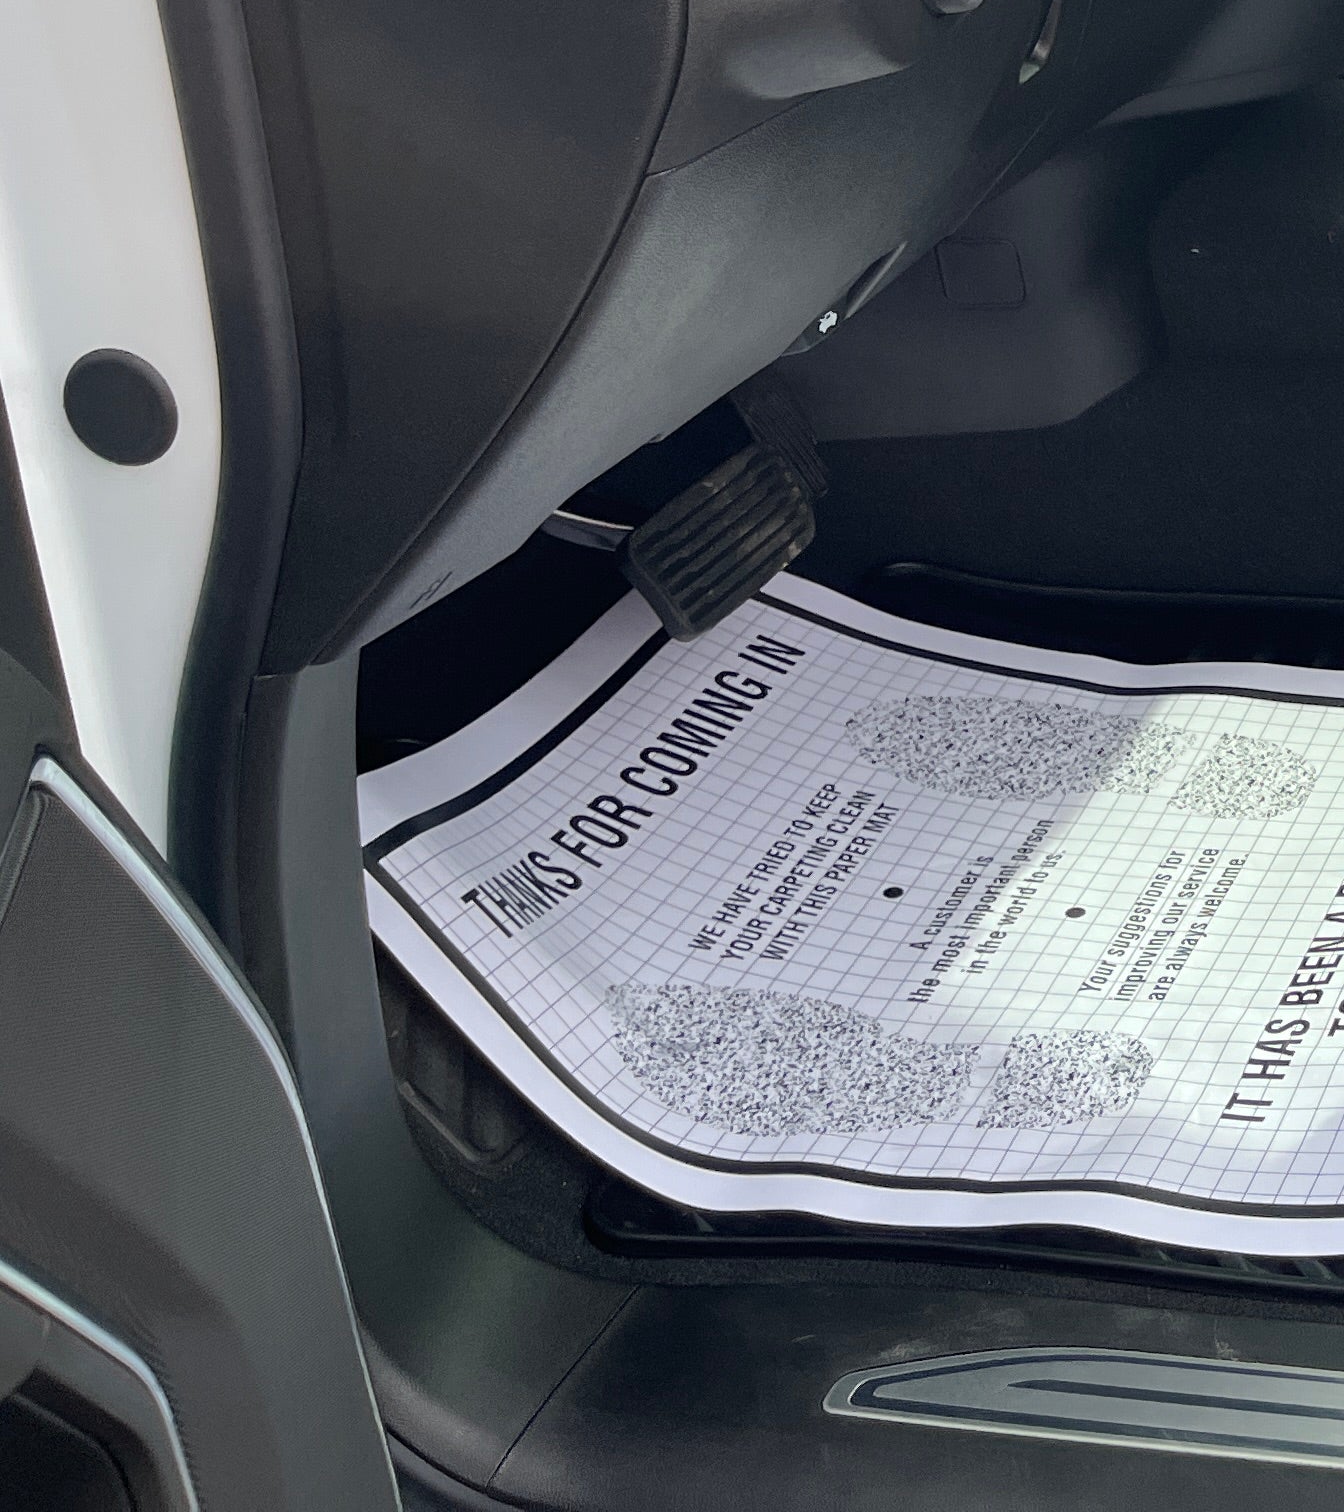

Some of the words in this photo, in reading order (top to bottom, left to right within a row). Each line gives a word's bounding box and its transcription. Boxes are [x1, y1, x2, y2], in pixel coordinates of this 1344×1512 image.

[460, 851, 583, 938] THANKS
[550, 794, 654, 868] FOR
[619, 670, 772, 796] COMING
[737, 634, 805, 675] IN
[688, 924, 726, 951] WE
[712, 884, 760, 924] HAVE
[746, 840, 795, 882] TRIED
[783, 819, 814, 838] TO
[802, 783, 842, 818] KEEP
[720, 918, 773, 961] YOUR
[760, 835, 838, 916] CARPETING
[827, 790, 876, 834] CLEAN
[759, 920, 809, 961] WITH
[794, 884, 838, 917] THIS
[824, 836, 877, 882] PAPER
[862, 802, 900, 834] MAT
[907, 978, 940, 1004] the
[932, 934, 970, 972] most
[955, 865, 1020, 930] important
[1011, 819, 1055, 862] person
[910, 940, 932, 950] A
[924, 871, 981, 936] customer
[968, 855, 994, 867] is
[997, 886, 1038, 926] world
[1024, 871, 1049, 883] to
[1041, 850, 1067, 867] us.
[961, 960, 989, 974] in
[974, 930, 1008, 955] the
[1077, 959, 1118, 992] Your
[1107, 873, 1173, 957] suggestions
[1158, 850, 1186, 870] for
[1108, 929, 1176, 1001] improving
[1161, 901, 1188, 925] our
[1178, 848, 1220, 898] service
[1148, 975, 1176, 1001] are
[1165, 921, 1208, 971] always
[1197, 853, 1250, 918] welcome.
[1219, 1092, 1274, 1123] IT
[1240, 1018, 1311, 1080] HAS
